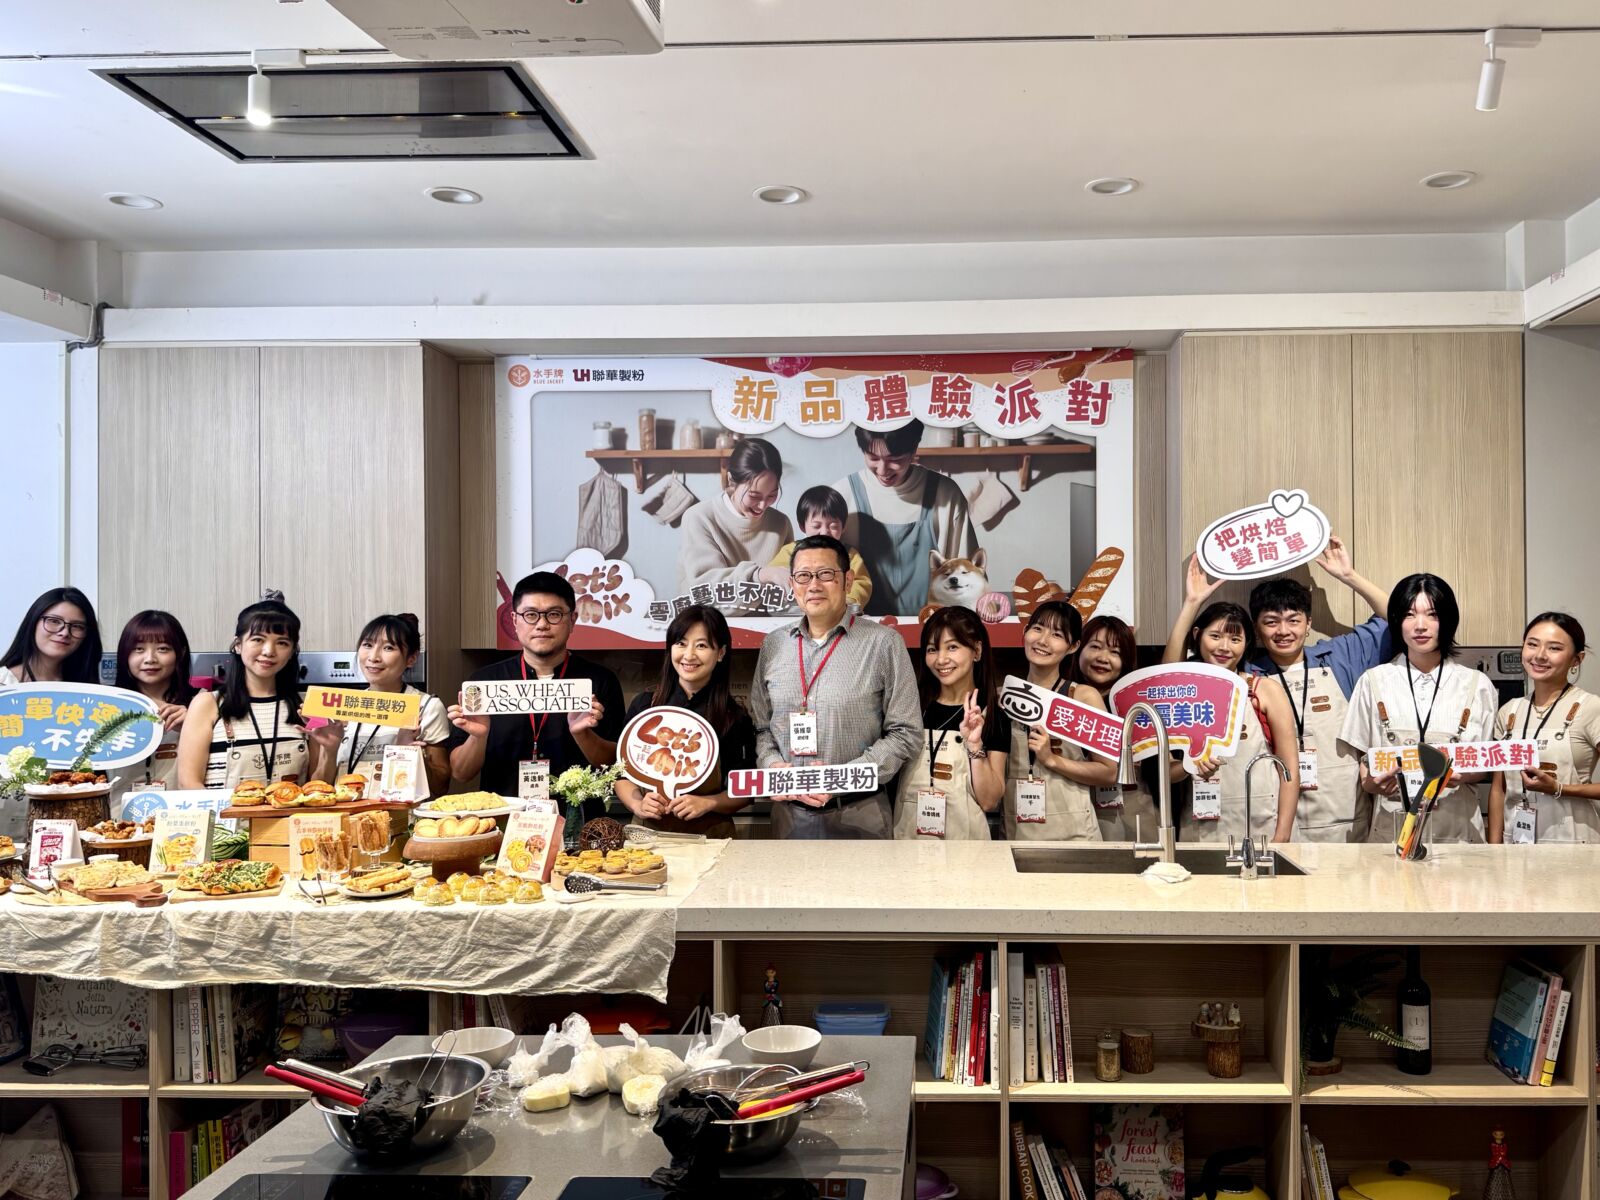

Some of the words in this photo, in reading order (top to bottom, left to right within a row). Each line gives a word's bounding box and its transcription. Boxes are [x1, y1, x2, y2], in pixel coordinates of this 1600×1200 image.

[533, 369, 564, 378] 水手牌
[592, 369, 645, 381] 聯華製粉
[731, 374, 1113, 426] 新品體驗派對
[1214, 517, 1288, 551] 把烘焙
[1231, 532, 1308, 570] 變簡單
[554, 564, 623, 594] et's
[486, 684, 511, 698] U.S.
[518, 683, 575, 698] WHEAT
[1138, 685, 1197, 699] 一起拌出你的
[344, 695, 406, 713] 聯華製粉
[486, 697, 590, 712] ASSOCIATES
[637, 715, 702, 753] Let's
[1051, 706, 1123, 751] 愛料理
[646, 747, 700, 778] Mix
[1375, 744, 1535, 773] 新品驗派對
[768, 766, 876, 794] 聯華製粉
[76, 1000, 113, 1016] Natura
[290, 996, 348, 1011] MADE
[1119, 1118, 1161, 1143] forest
[1014, 1130, 1029, 1167] URBAN
[1122, 1138, 1159, 1161] feast
